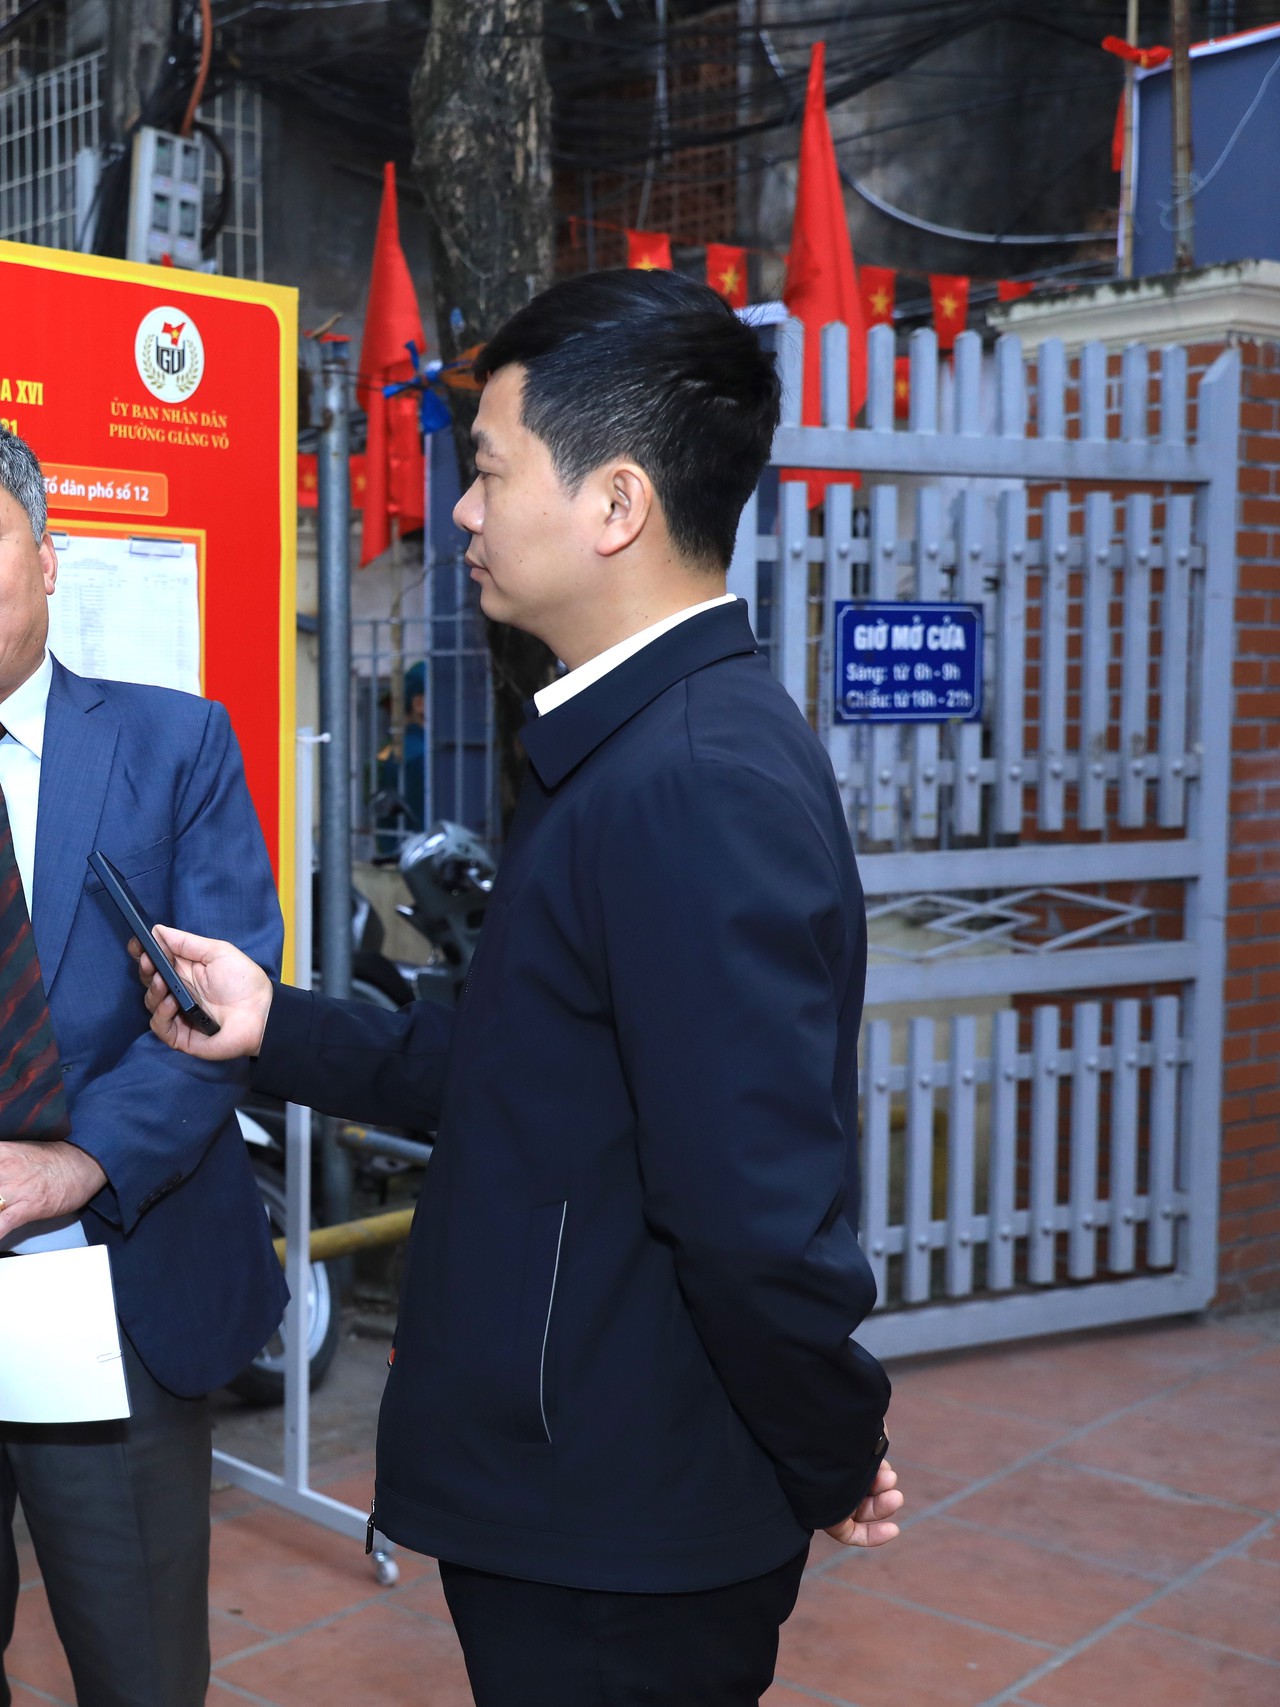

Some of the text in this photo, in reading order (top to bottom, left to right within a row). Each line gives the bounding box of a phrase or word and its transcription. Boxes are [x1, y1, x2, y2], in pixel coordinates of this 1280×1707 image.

[15, 379, 44, 406] XVI
[132, 404, 159, 420] BAN
[162, 407, 198, 425] NHÂN
[201, 410, 228, 428] DÂN
[109, 421, 165, 443] PHƯỜNG
[168, 427, 209, 447] GIẢNG
[60, 478, 85, 496] dân
[88, 480, 114, 501] phố
[115, 482, 132, 500] số
[133, 486, 149, 502] 12
[853, 615, 966, 651] GIỜ MỞ CỬA
